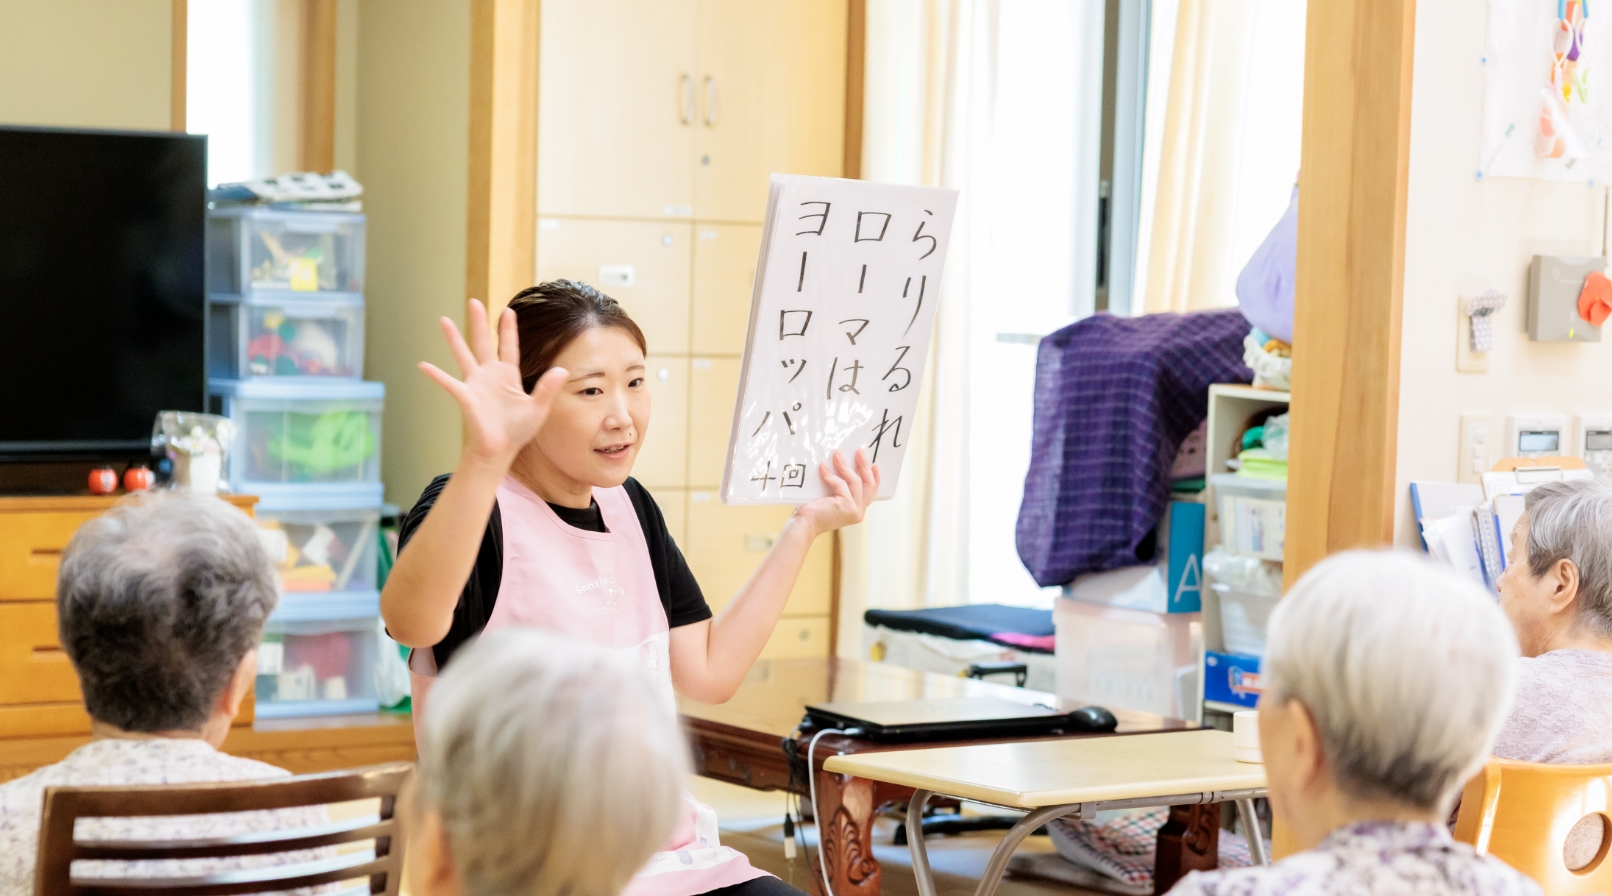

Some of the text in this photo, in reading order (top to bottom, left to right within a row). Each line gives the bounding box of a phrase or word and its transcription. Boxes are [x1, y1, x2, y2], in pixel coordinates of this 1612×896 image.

[751, 201, 832, 438] ヨーロッパ
[826, 210, 893, 400] ローマは
[868, 209, 938, 464] らりるれ
